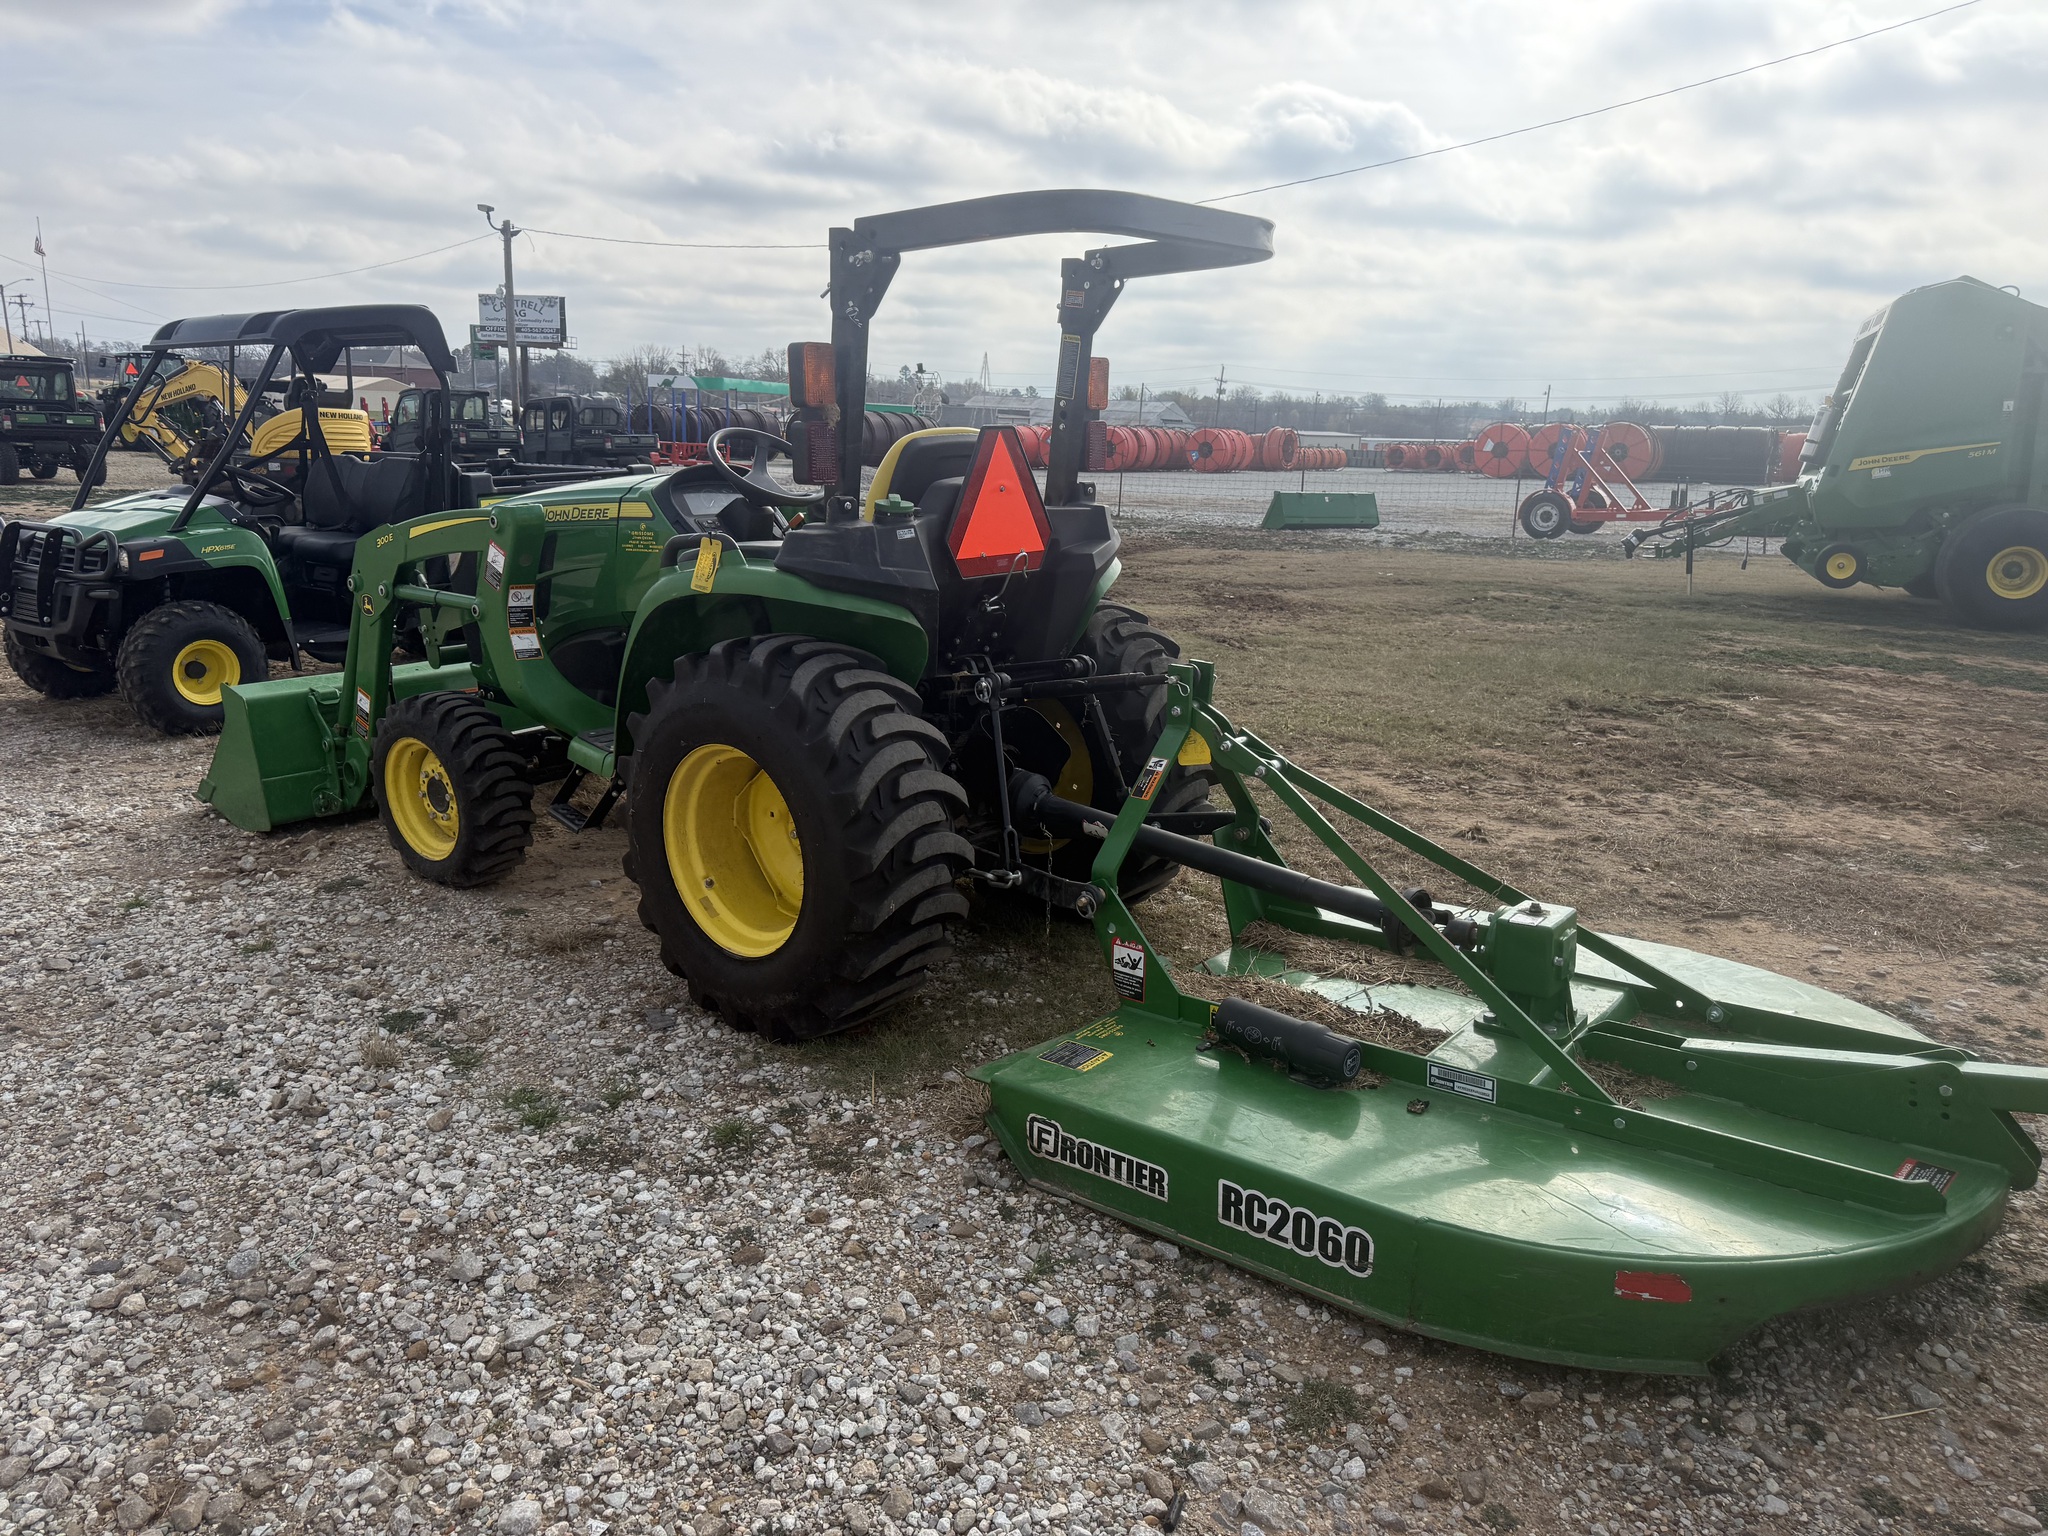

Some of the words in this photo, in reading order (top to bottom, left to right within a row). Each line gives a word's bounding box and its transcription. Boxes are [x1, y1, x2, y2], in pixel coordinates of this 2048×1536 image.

[492, 299, 545, 315] CATRELL
[160, 390, 172, 401] NEW
[172, 383, 196, 397] HOLLAND
[319, 411, 337, 419] NEW
[337, 412, 364, 420] HOLLAND
[1858, 458, 1881, 467] JOHN
[1881, 454, 1911, 464] DEERE
[545, 508, 571, 522] JOHN
[571, 507, 610, 520] DEERE
[1028, 1116, 1167, 1199] FRONTIER
[1221, 1182, 1371, 1275] RC2060
